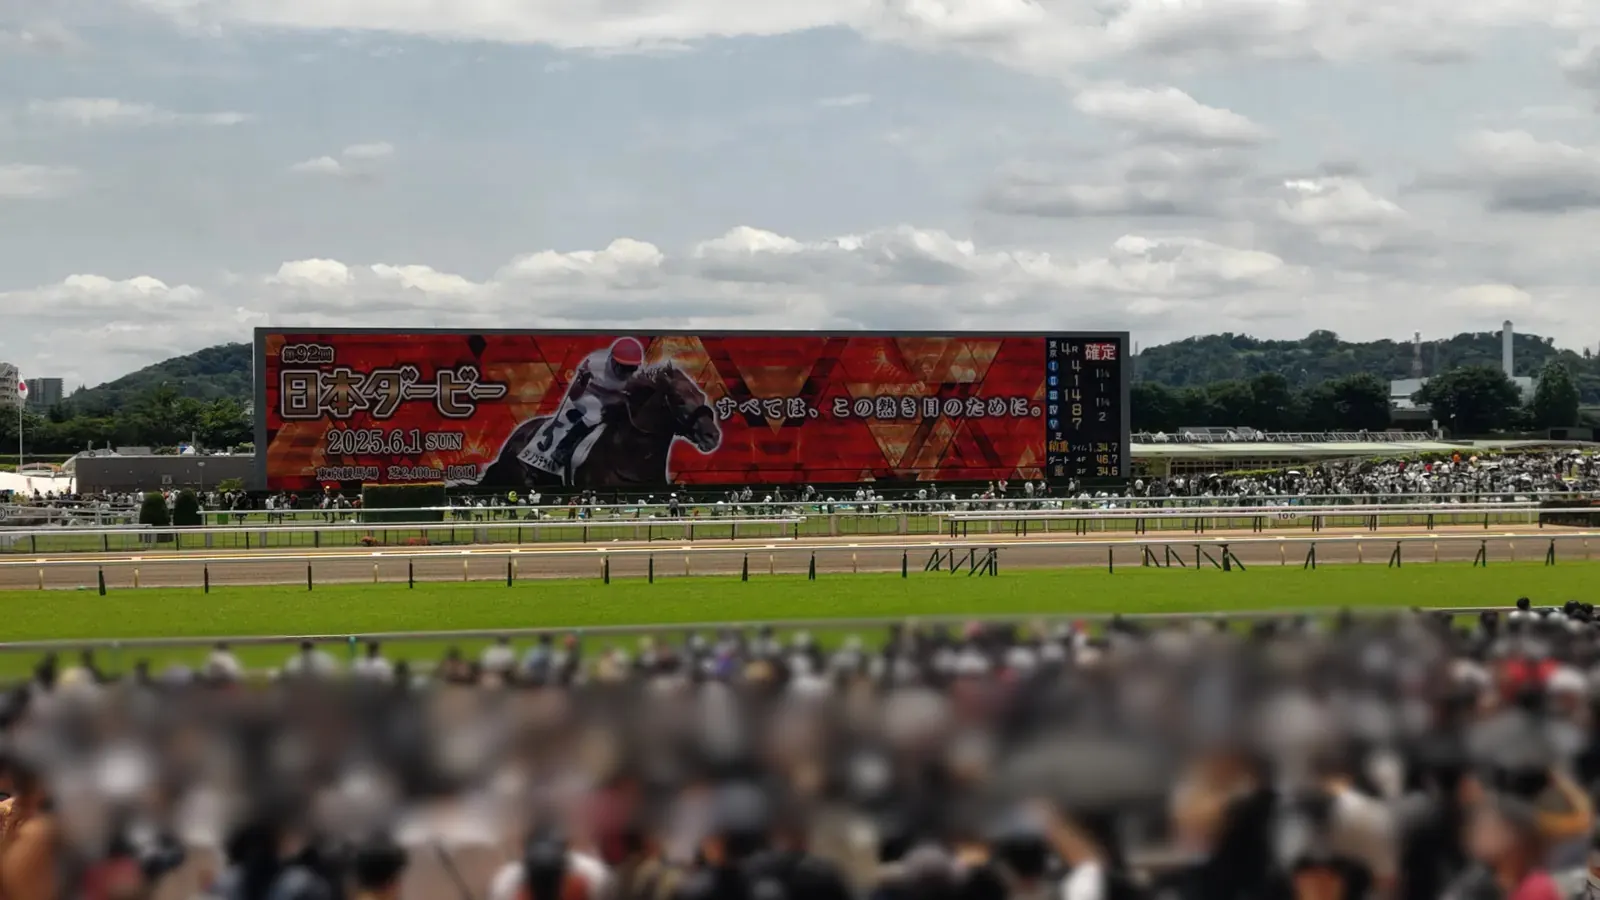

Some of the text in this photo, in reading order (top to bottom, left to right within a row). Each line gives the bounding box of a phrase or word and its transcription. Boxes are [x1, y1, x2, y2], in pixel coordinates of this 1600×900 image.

[1049, 340, 1058, 358] 東京
[1085, 344, 1116, 360] 確定
[1072, 360, 1082, 373] 4
[1074, 374, 1079, 386] 1
[281, 366, 507, 418] 日本ダービー
[1064, 389, 1081, 402] 14
[716, 397, 1041, 420] すべては、この熱き日のために。
[1072, 403, 1082, 416] 8
[1098, 411, 1106, 421] 2
[1072, 417, 1082, 430] 7
[327, 429, 463, 454] 2025.6.1 SUN
[1089, 442, 1118, 452] 1.34.7
[1049, 456, 1070, 464] ダート
[1096, 454, 1118, 464] 46.7
[316, 466, 379, 481] 東京競馬場
[1096, 466, 1118, 476] 34.6
